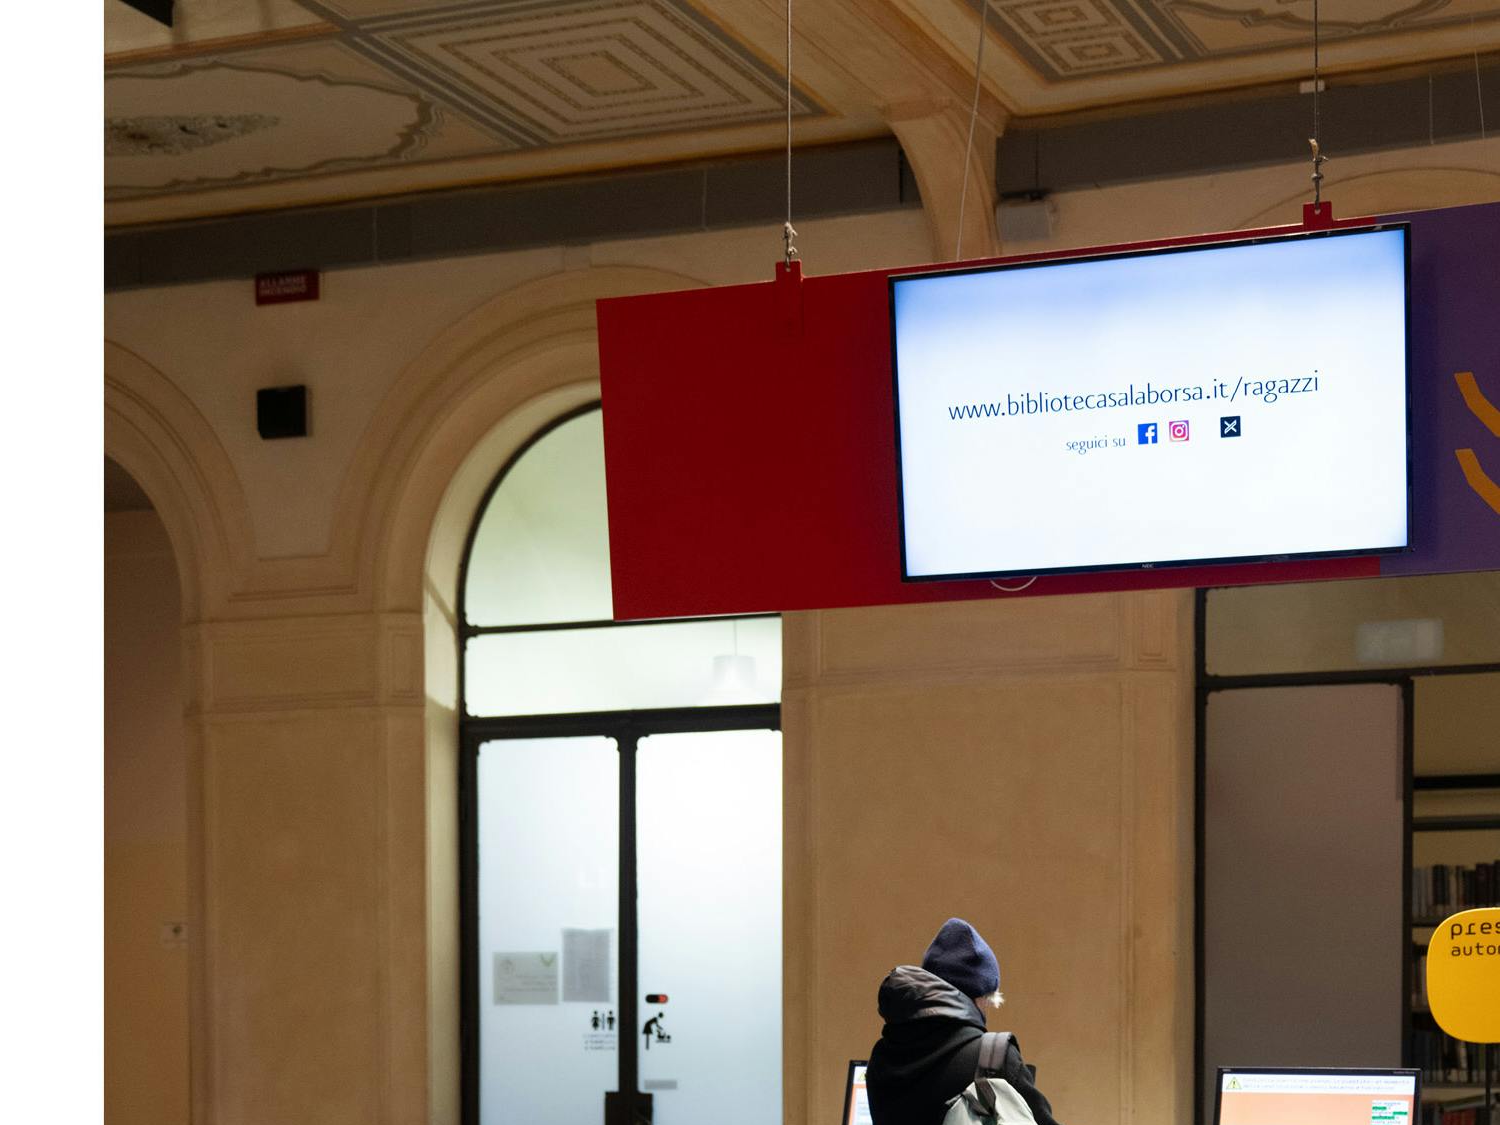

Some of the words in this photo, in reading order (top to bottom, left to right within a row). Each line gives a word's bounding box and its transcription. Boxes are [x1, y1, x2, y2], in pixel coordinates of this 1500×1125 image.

[948, 370, 1319, 420] www.bibliotecasalaborsa.it/ragazzi
[1066, 436, 1109, 455] seguici
[1112, 436, 1126, 448] su
[1451, 942, 1500, 957] auto
